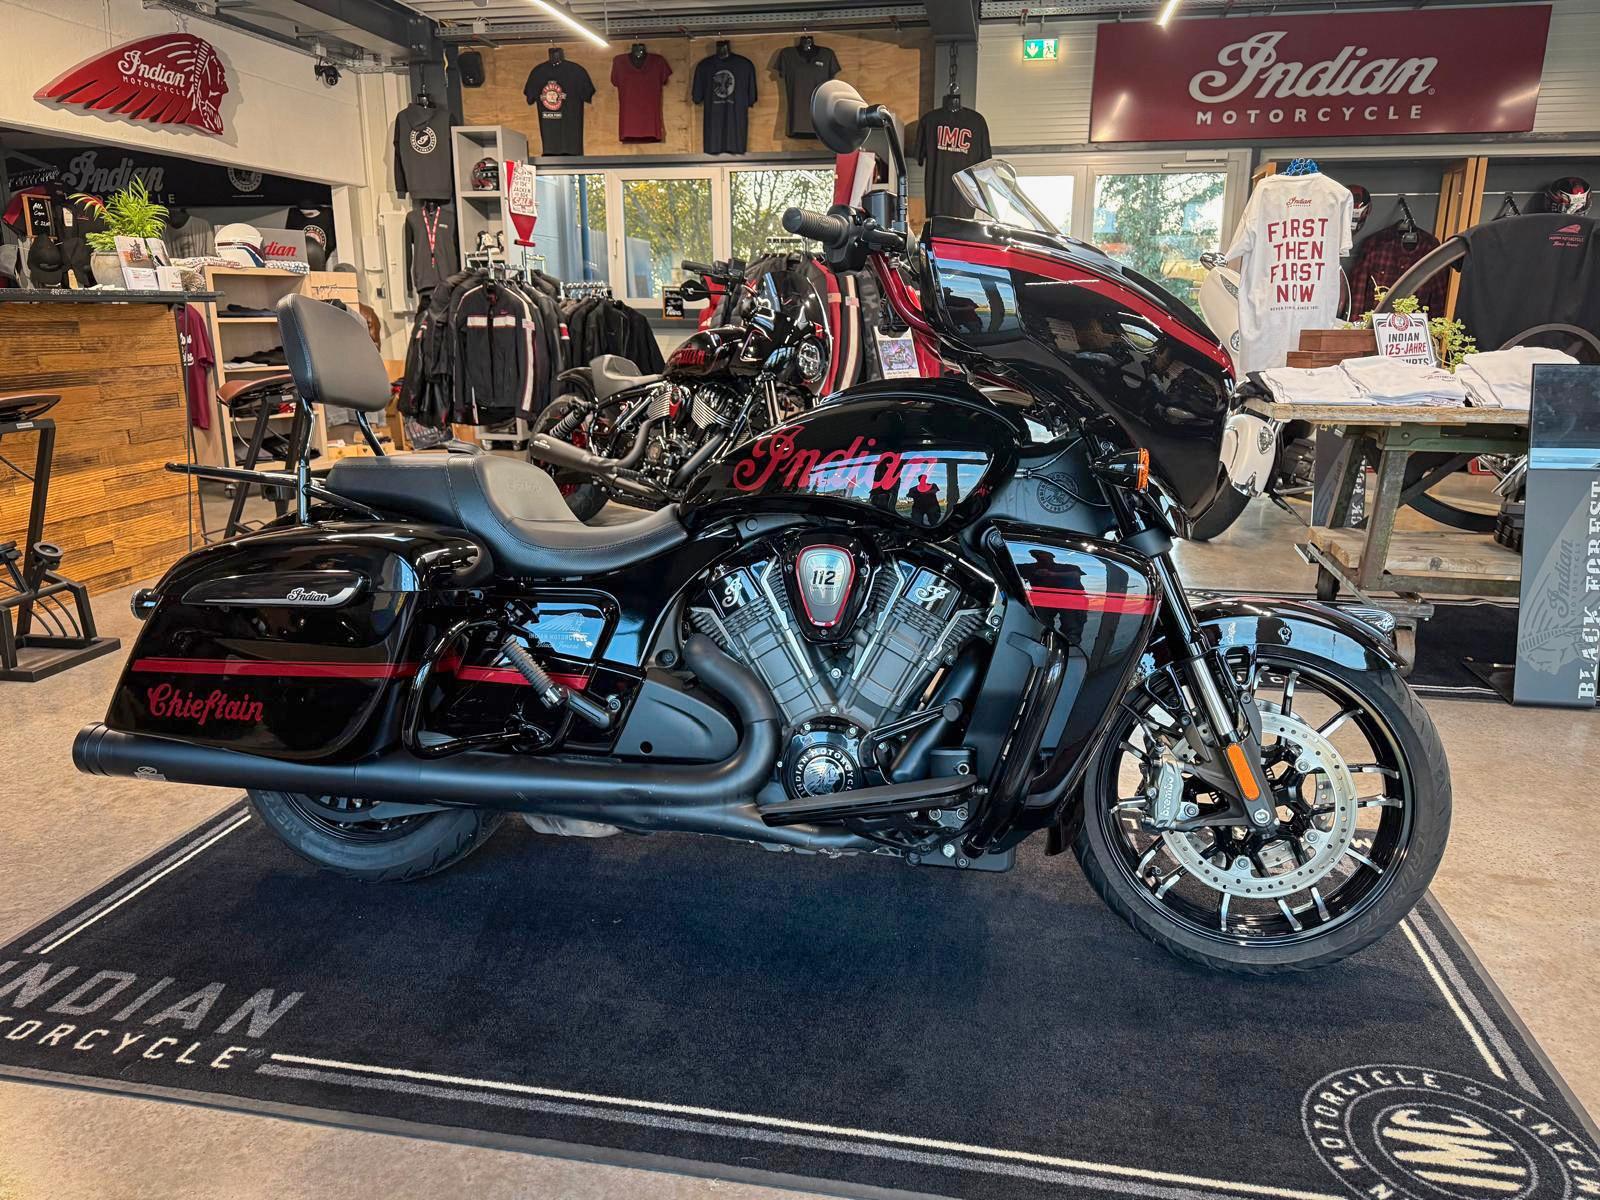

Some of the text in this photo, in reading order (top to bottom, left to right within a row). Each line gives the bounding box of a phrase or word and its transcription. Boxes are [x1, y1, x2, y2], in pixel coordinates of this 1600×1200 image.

[117, 50, 185, 87] Indian
[1188, 31, 1438, 103] Indian
[122, 75, 186, 97] MOTORCYCLE
[1196, 105, 1422, 125] MOTORCYCLE
[937, 125, 972, 149] IMC
[61, 150, 165, 193] Indian
[264, 241, 297, 257] dian
[1273, 241, 1323, 261] THEN
[1276, 284, 1315, 303] NOW
[1385, 342, 1427, 355] 125-JAHRE
[1388, 332, 1420, 343] INDIAN
[732, 425, 938, 493] Indian
[812, 570, 836, 585] 112
[1547, 538, 1575, 618] Indian
[286, 587, 329, 602] Indian
[147, 683, 263, 725] Chieftain
[1160, 777, 1174, 817] brembo
[1312, 1070, 1441, 1170] MOTORCYCLE
